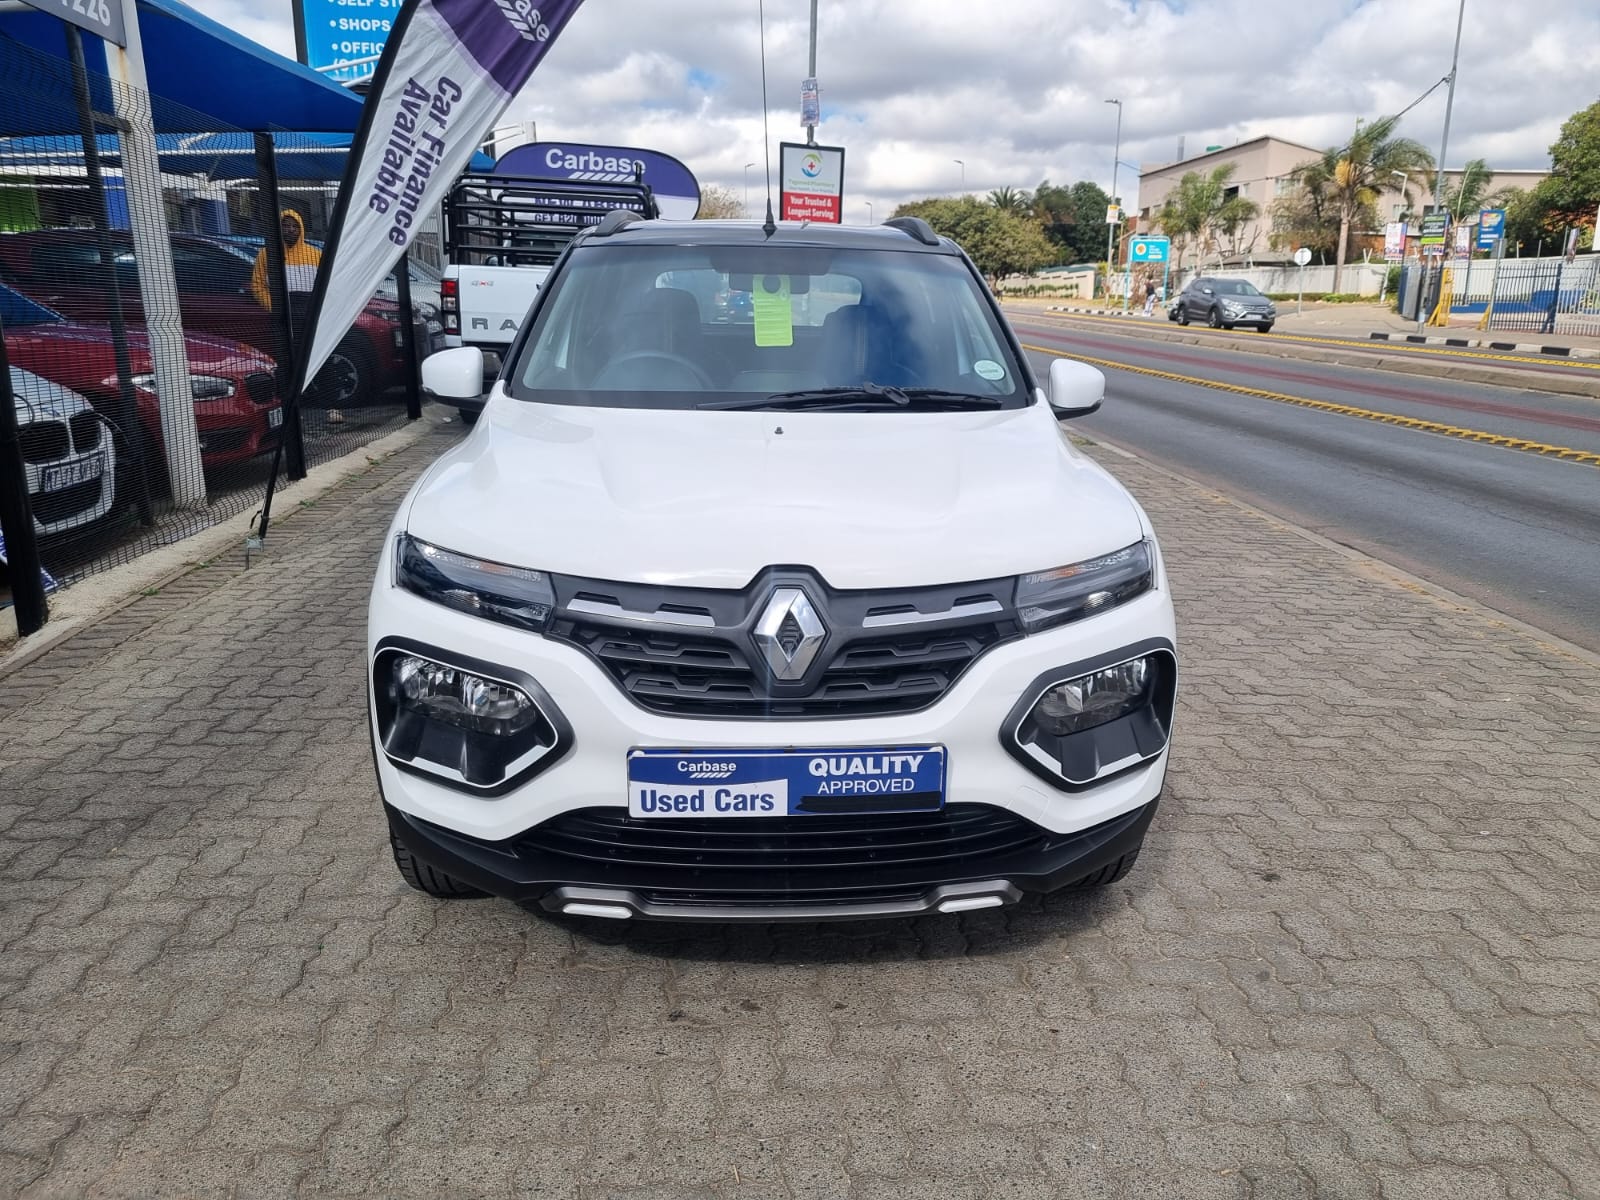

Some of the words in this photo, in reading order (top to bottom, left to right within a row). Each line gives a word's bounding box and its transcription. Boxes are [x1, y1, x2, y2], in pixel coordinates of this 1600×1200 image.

[338, 18, 391, 31] SHOPS
[429, 76, 463, 130] Car
[368, 77, 432, 215] Available
[545, 148, 646, 175] Carbase
[388, 130, 447, 247] Finance
[790, 195, 804, 205] Your
[804, 196, 826, 207] Trusted
[787, 206, 811, 218] Longest
[812, 208, 835, 220] Serving
[677, 760, 737, 773] Carbase
[808, 755, 924, 777] QUALITY
[817, 778, 915, 795] APPROVED
[640, 789, 705, 813] Used
[714, 788, 775, 812] Cars
